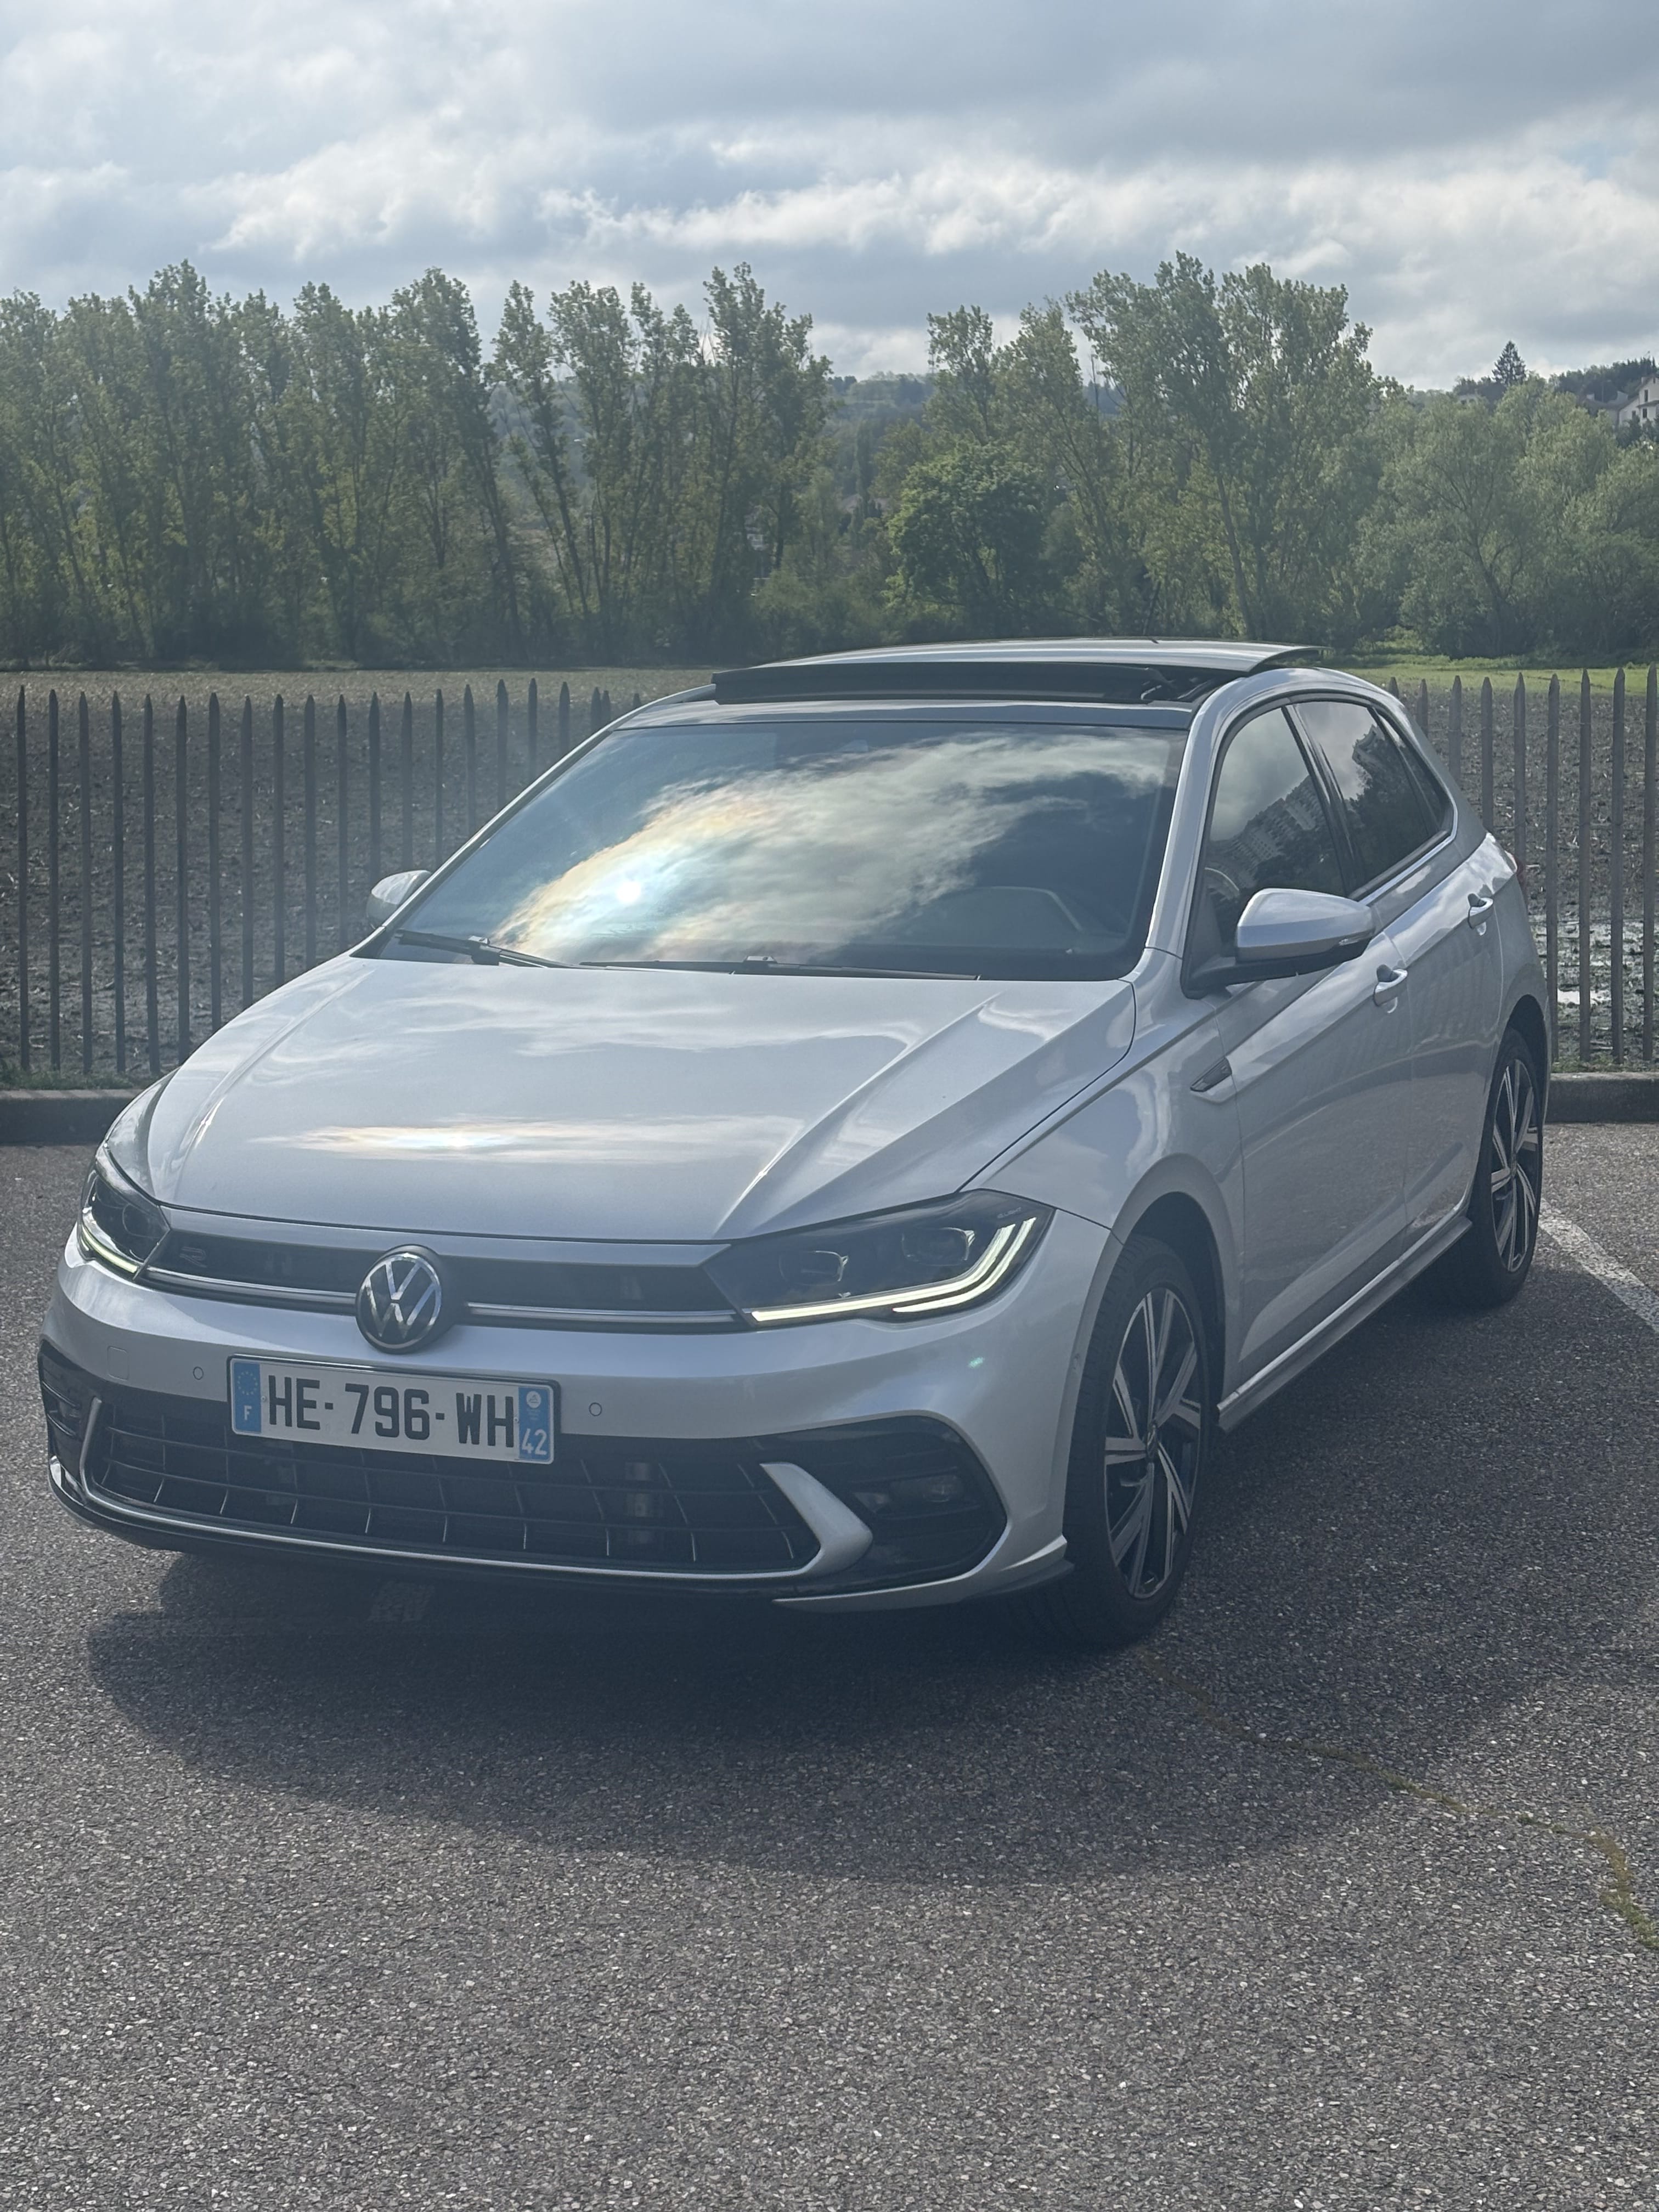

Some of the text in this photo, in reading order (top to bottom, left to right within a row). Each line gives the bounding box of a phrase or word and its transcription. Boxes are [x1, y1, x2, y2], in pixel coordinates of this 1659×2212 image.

[362, 1258, 440, 1340] VW
[244, 1405, 252, 1421] F
[268, 1375, 514, 1448] HE-796-WH
[521, 1428, 548, 1455] 42
